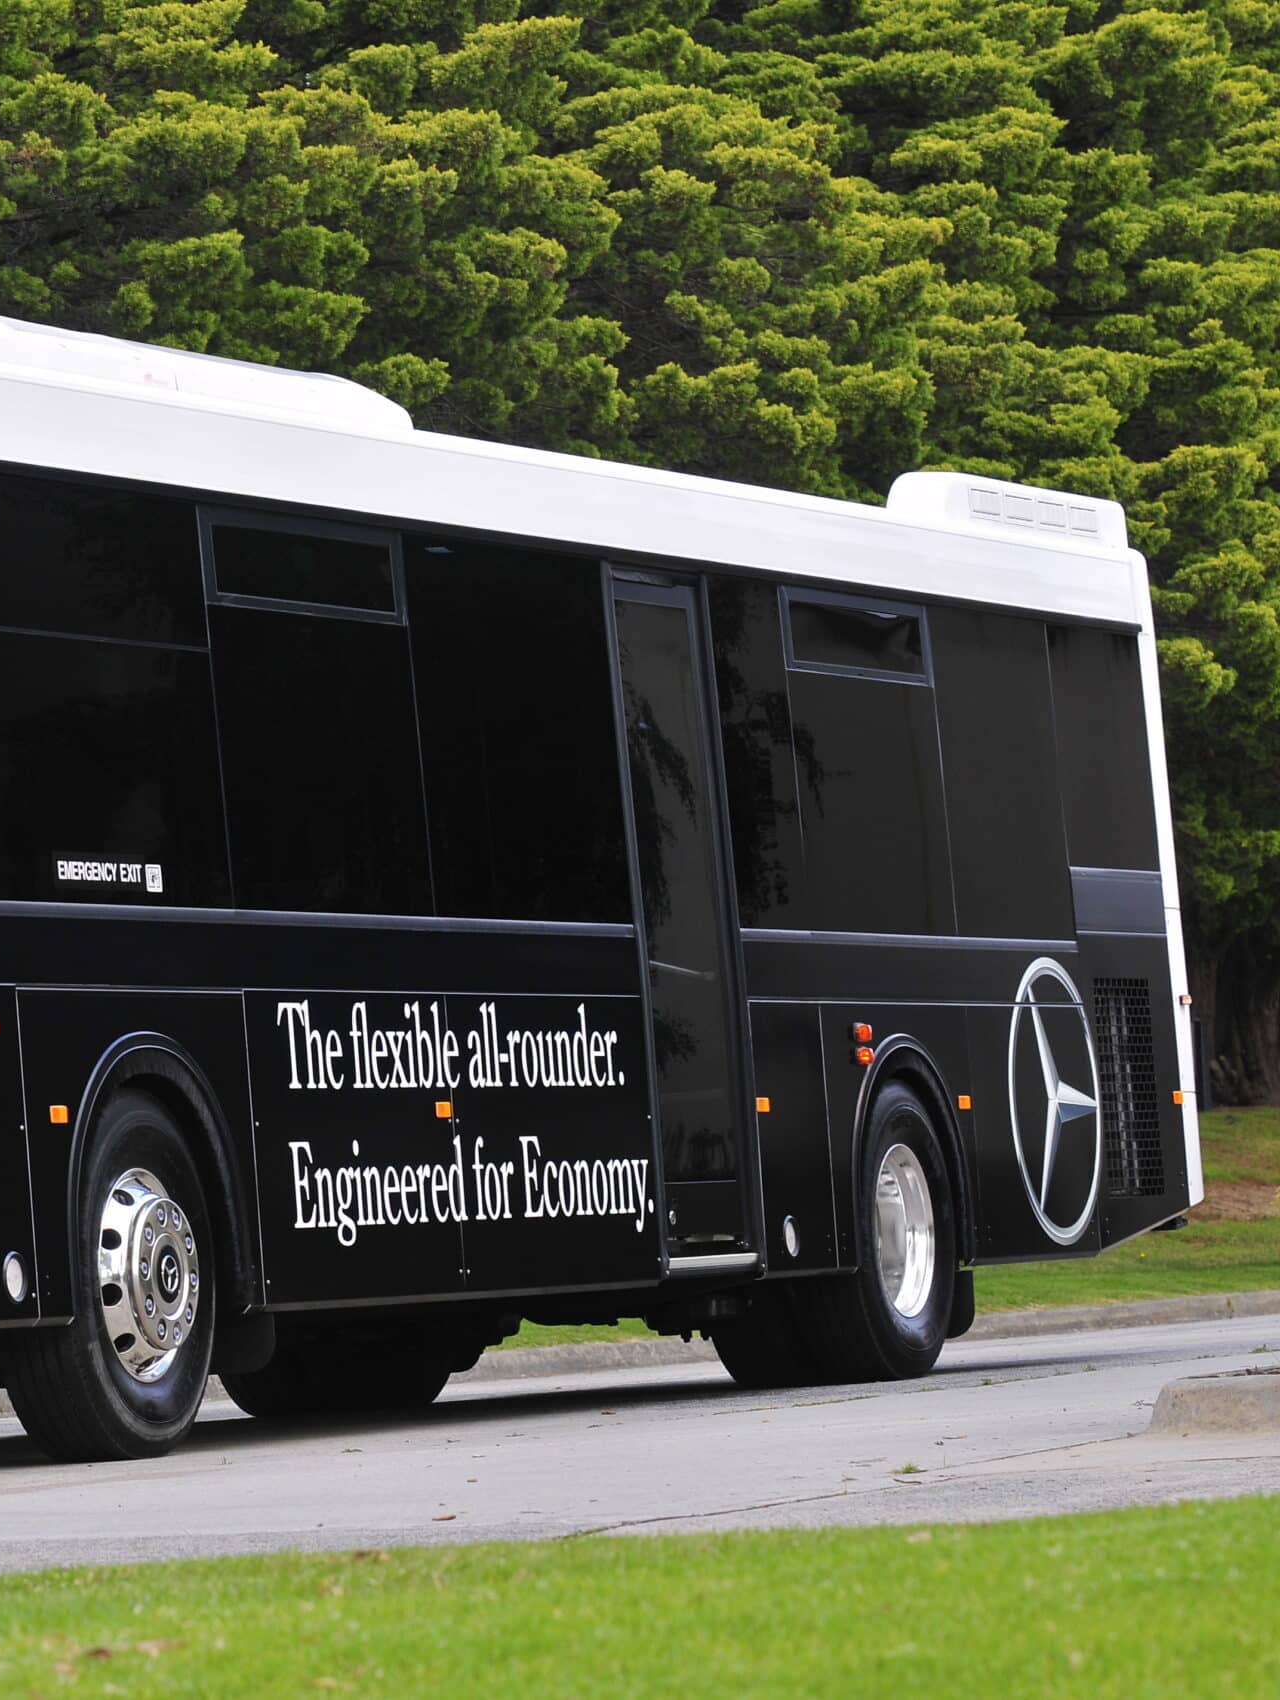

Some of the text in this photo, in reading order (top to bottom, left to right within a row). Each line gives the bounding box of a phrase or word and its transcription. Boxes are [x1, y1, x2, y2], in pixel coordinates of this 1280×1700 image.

[57, 860, 142, 883] EMERGENCY EXIT
[276, 1000, 625, 1090] The flexible all-rounder.
[288, 1135, 655, 1247] Engineered for Economy.
